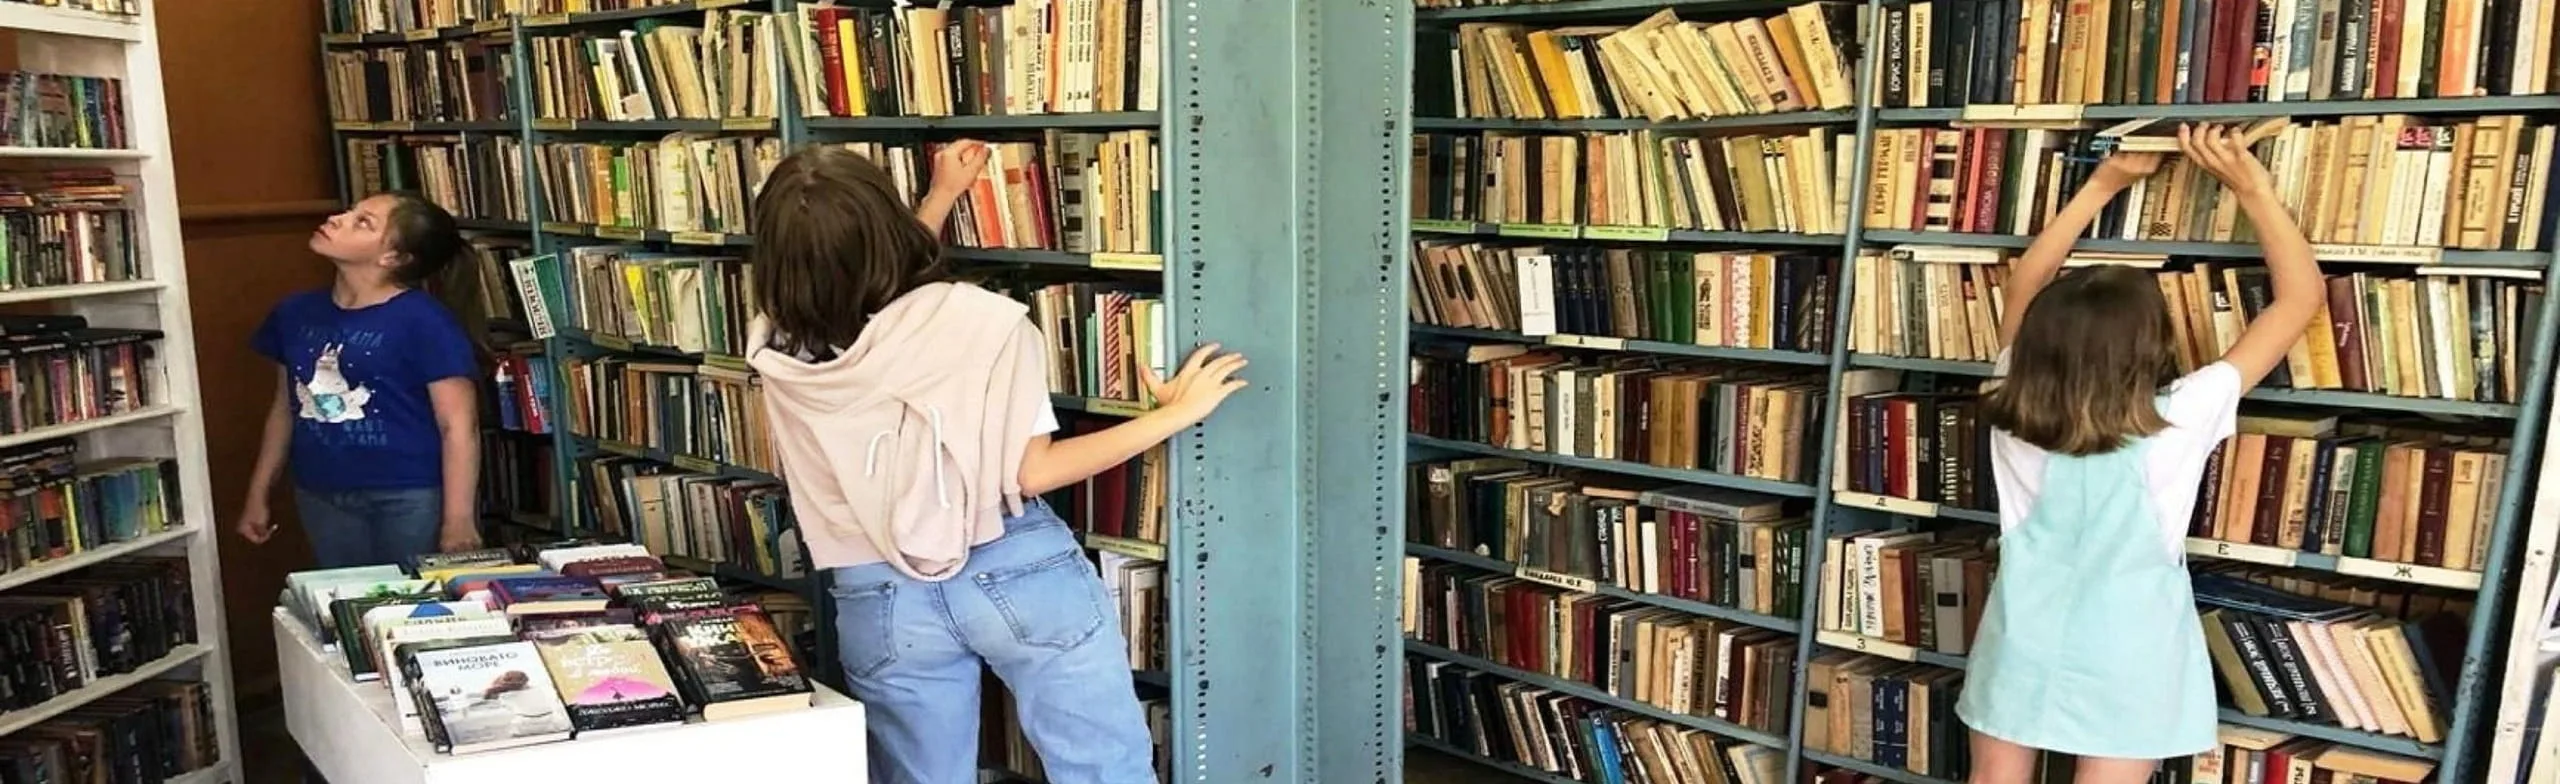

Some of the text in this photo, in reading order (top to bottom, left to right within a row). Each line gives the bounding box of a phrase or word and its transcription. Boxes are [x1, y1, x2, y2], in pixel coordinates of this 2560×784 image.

[2217, 543, 2229, 555] Е
[2395, 565, 2413, 579] Ж
[433, 651, 519, 668] ВИНОВАТО
[458, 660, 500, 672] МОРЕ
